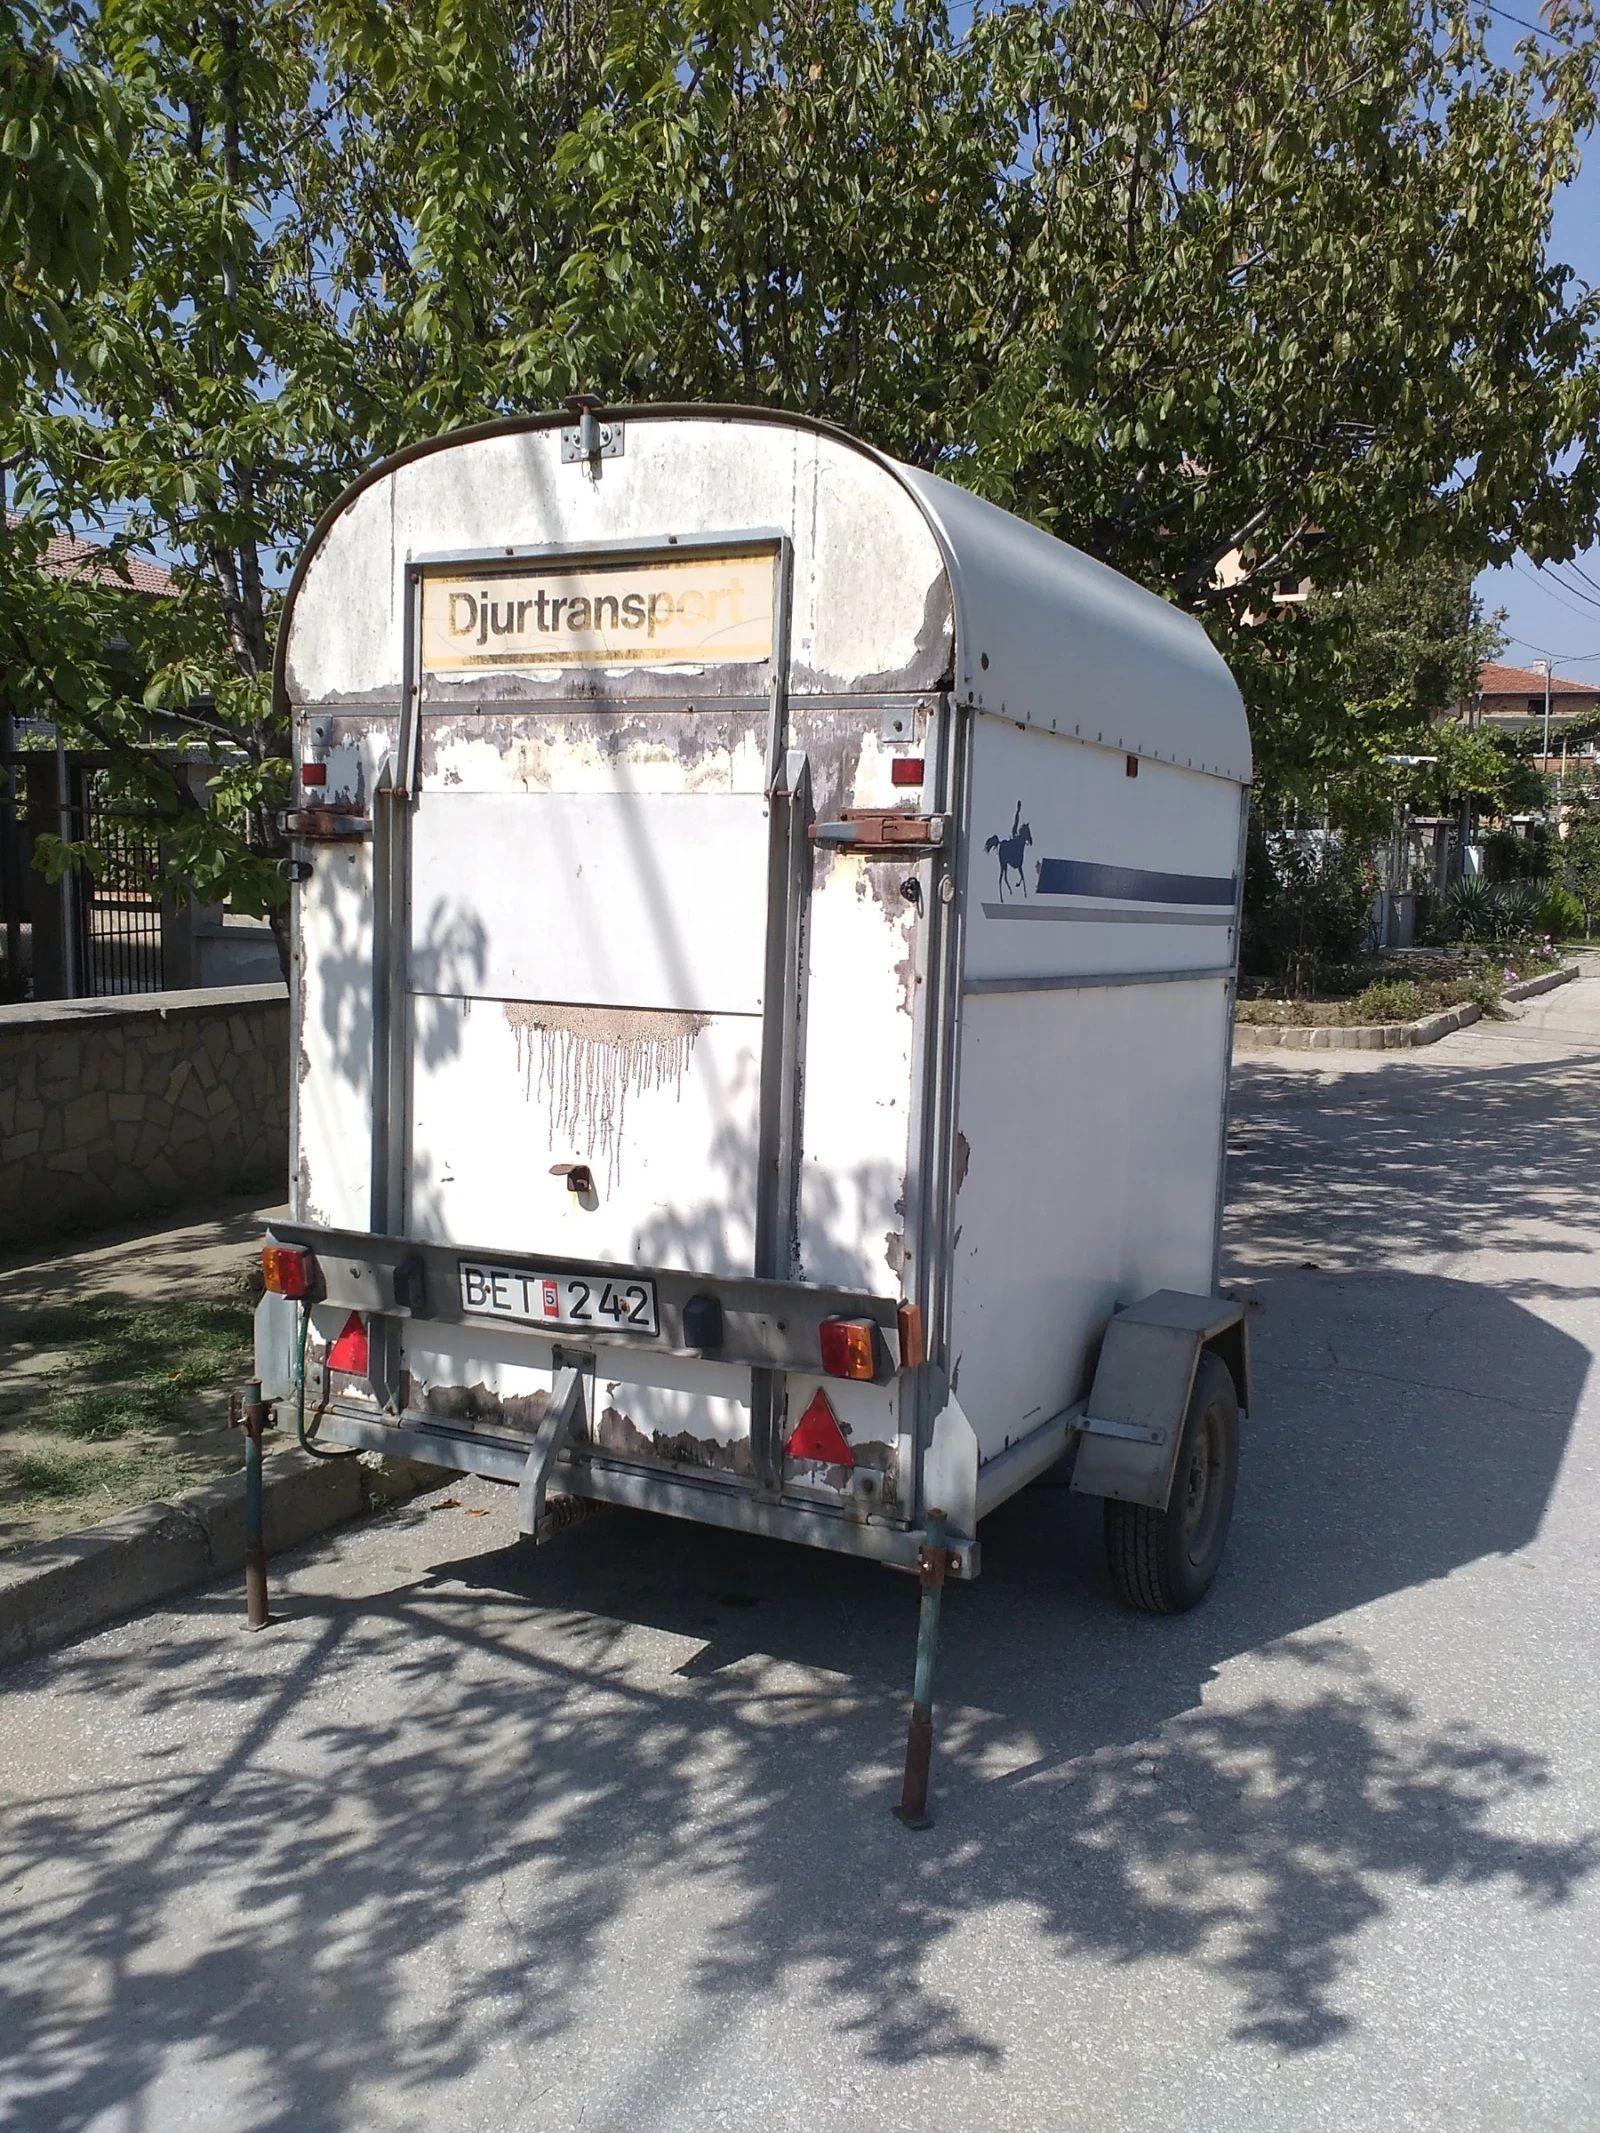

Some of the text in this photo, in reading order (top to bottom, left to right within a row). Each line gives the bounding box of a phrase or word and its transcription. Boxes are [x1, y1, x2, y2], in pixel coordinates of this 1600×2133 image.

[448, 577, 745, 646] Djurtransport
[464, 1267, 535, 1314] BET
[567, 1280, 650, 1326] 242
